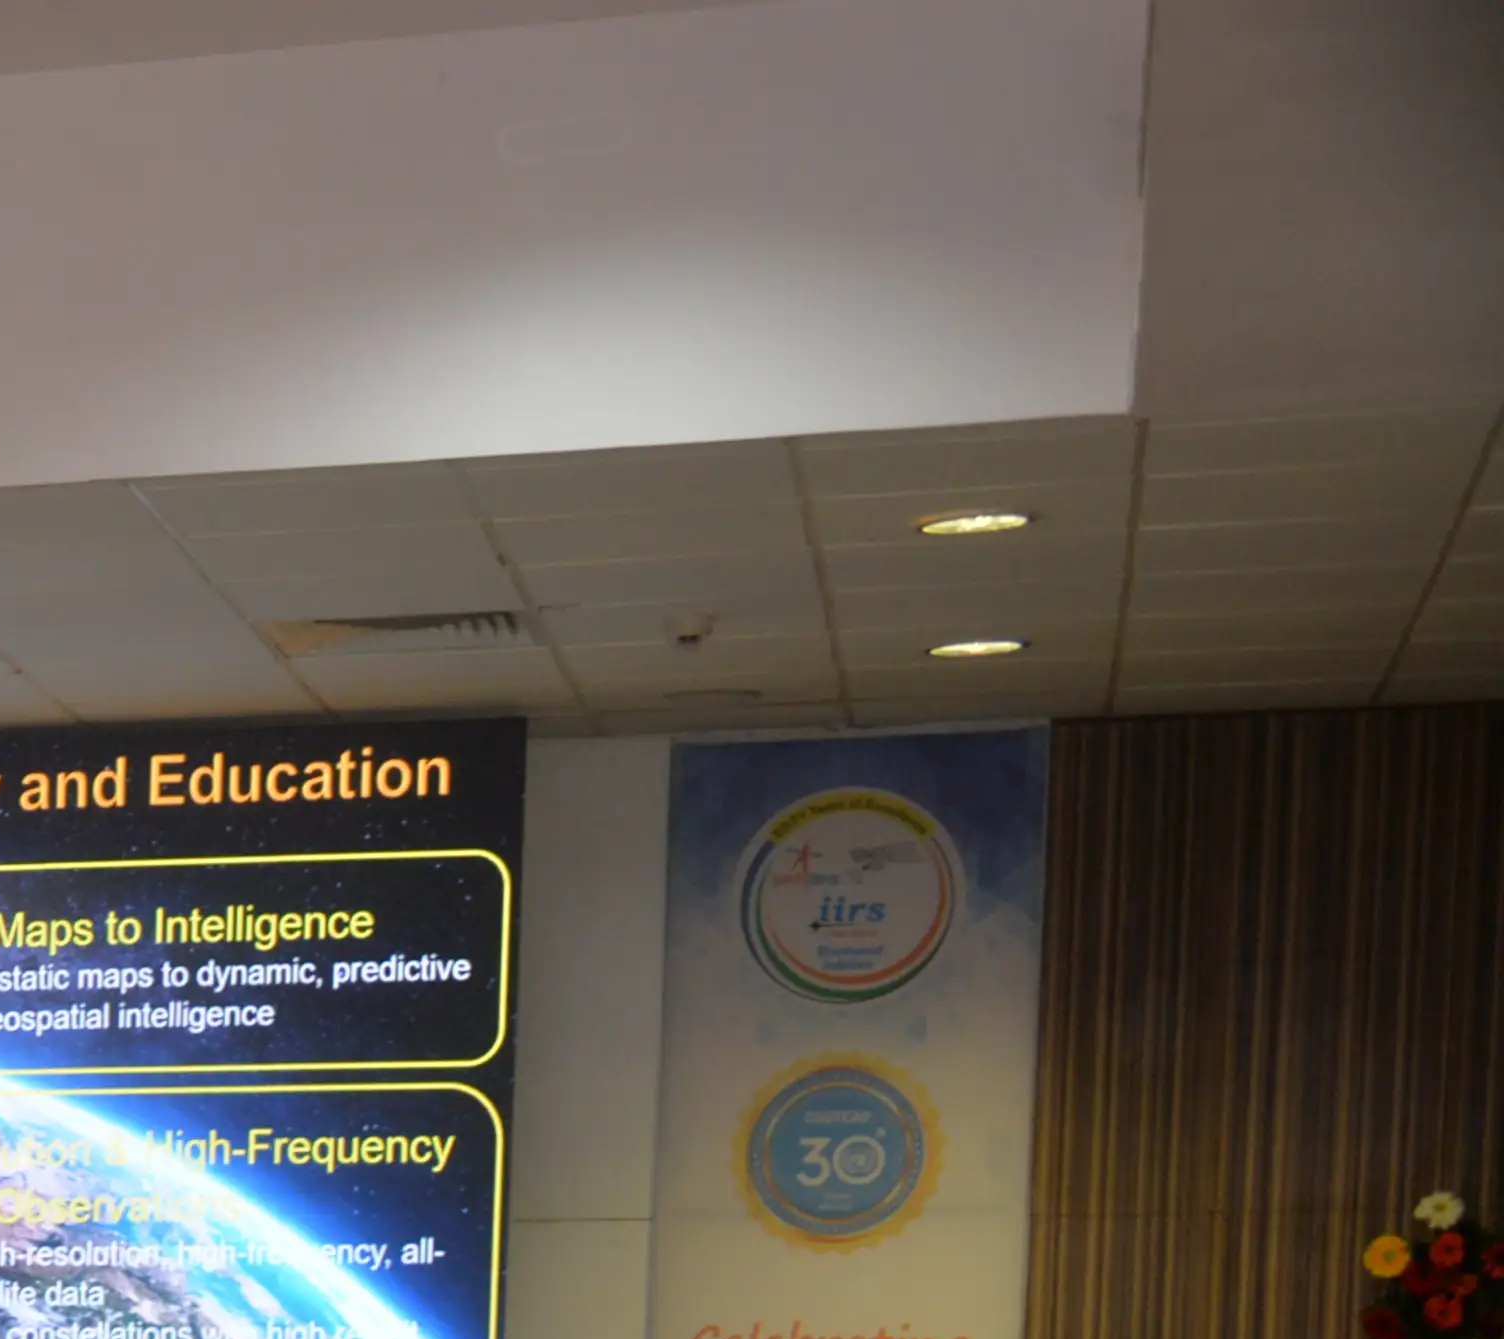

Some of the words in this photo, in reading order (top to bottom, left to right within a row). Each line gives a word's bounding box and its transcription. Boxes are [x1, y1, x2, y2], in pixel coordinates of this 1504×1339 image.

[19, 756, 126, 811] and
[149, 747, 452, 806] Education
[106, 911, 141, 944] to
[154, 905, 375, 944] Intelligence
[818, 897, 886, 923] iirs
[77, 964, 154, 995] maps
[161, 961, 188, 988] to
[196, 958, 324, 994] dynamic,
[333, 955, 471, 989] predictive
[118, 1000, 275, 1034] intelligence
[145, 1129, 456, 1174] High-Frequency
[401, 1238, 445, 1266] all-
[45, 1281, 105, 1307] data
